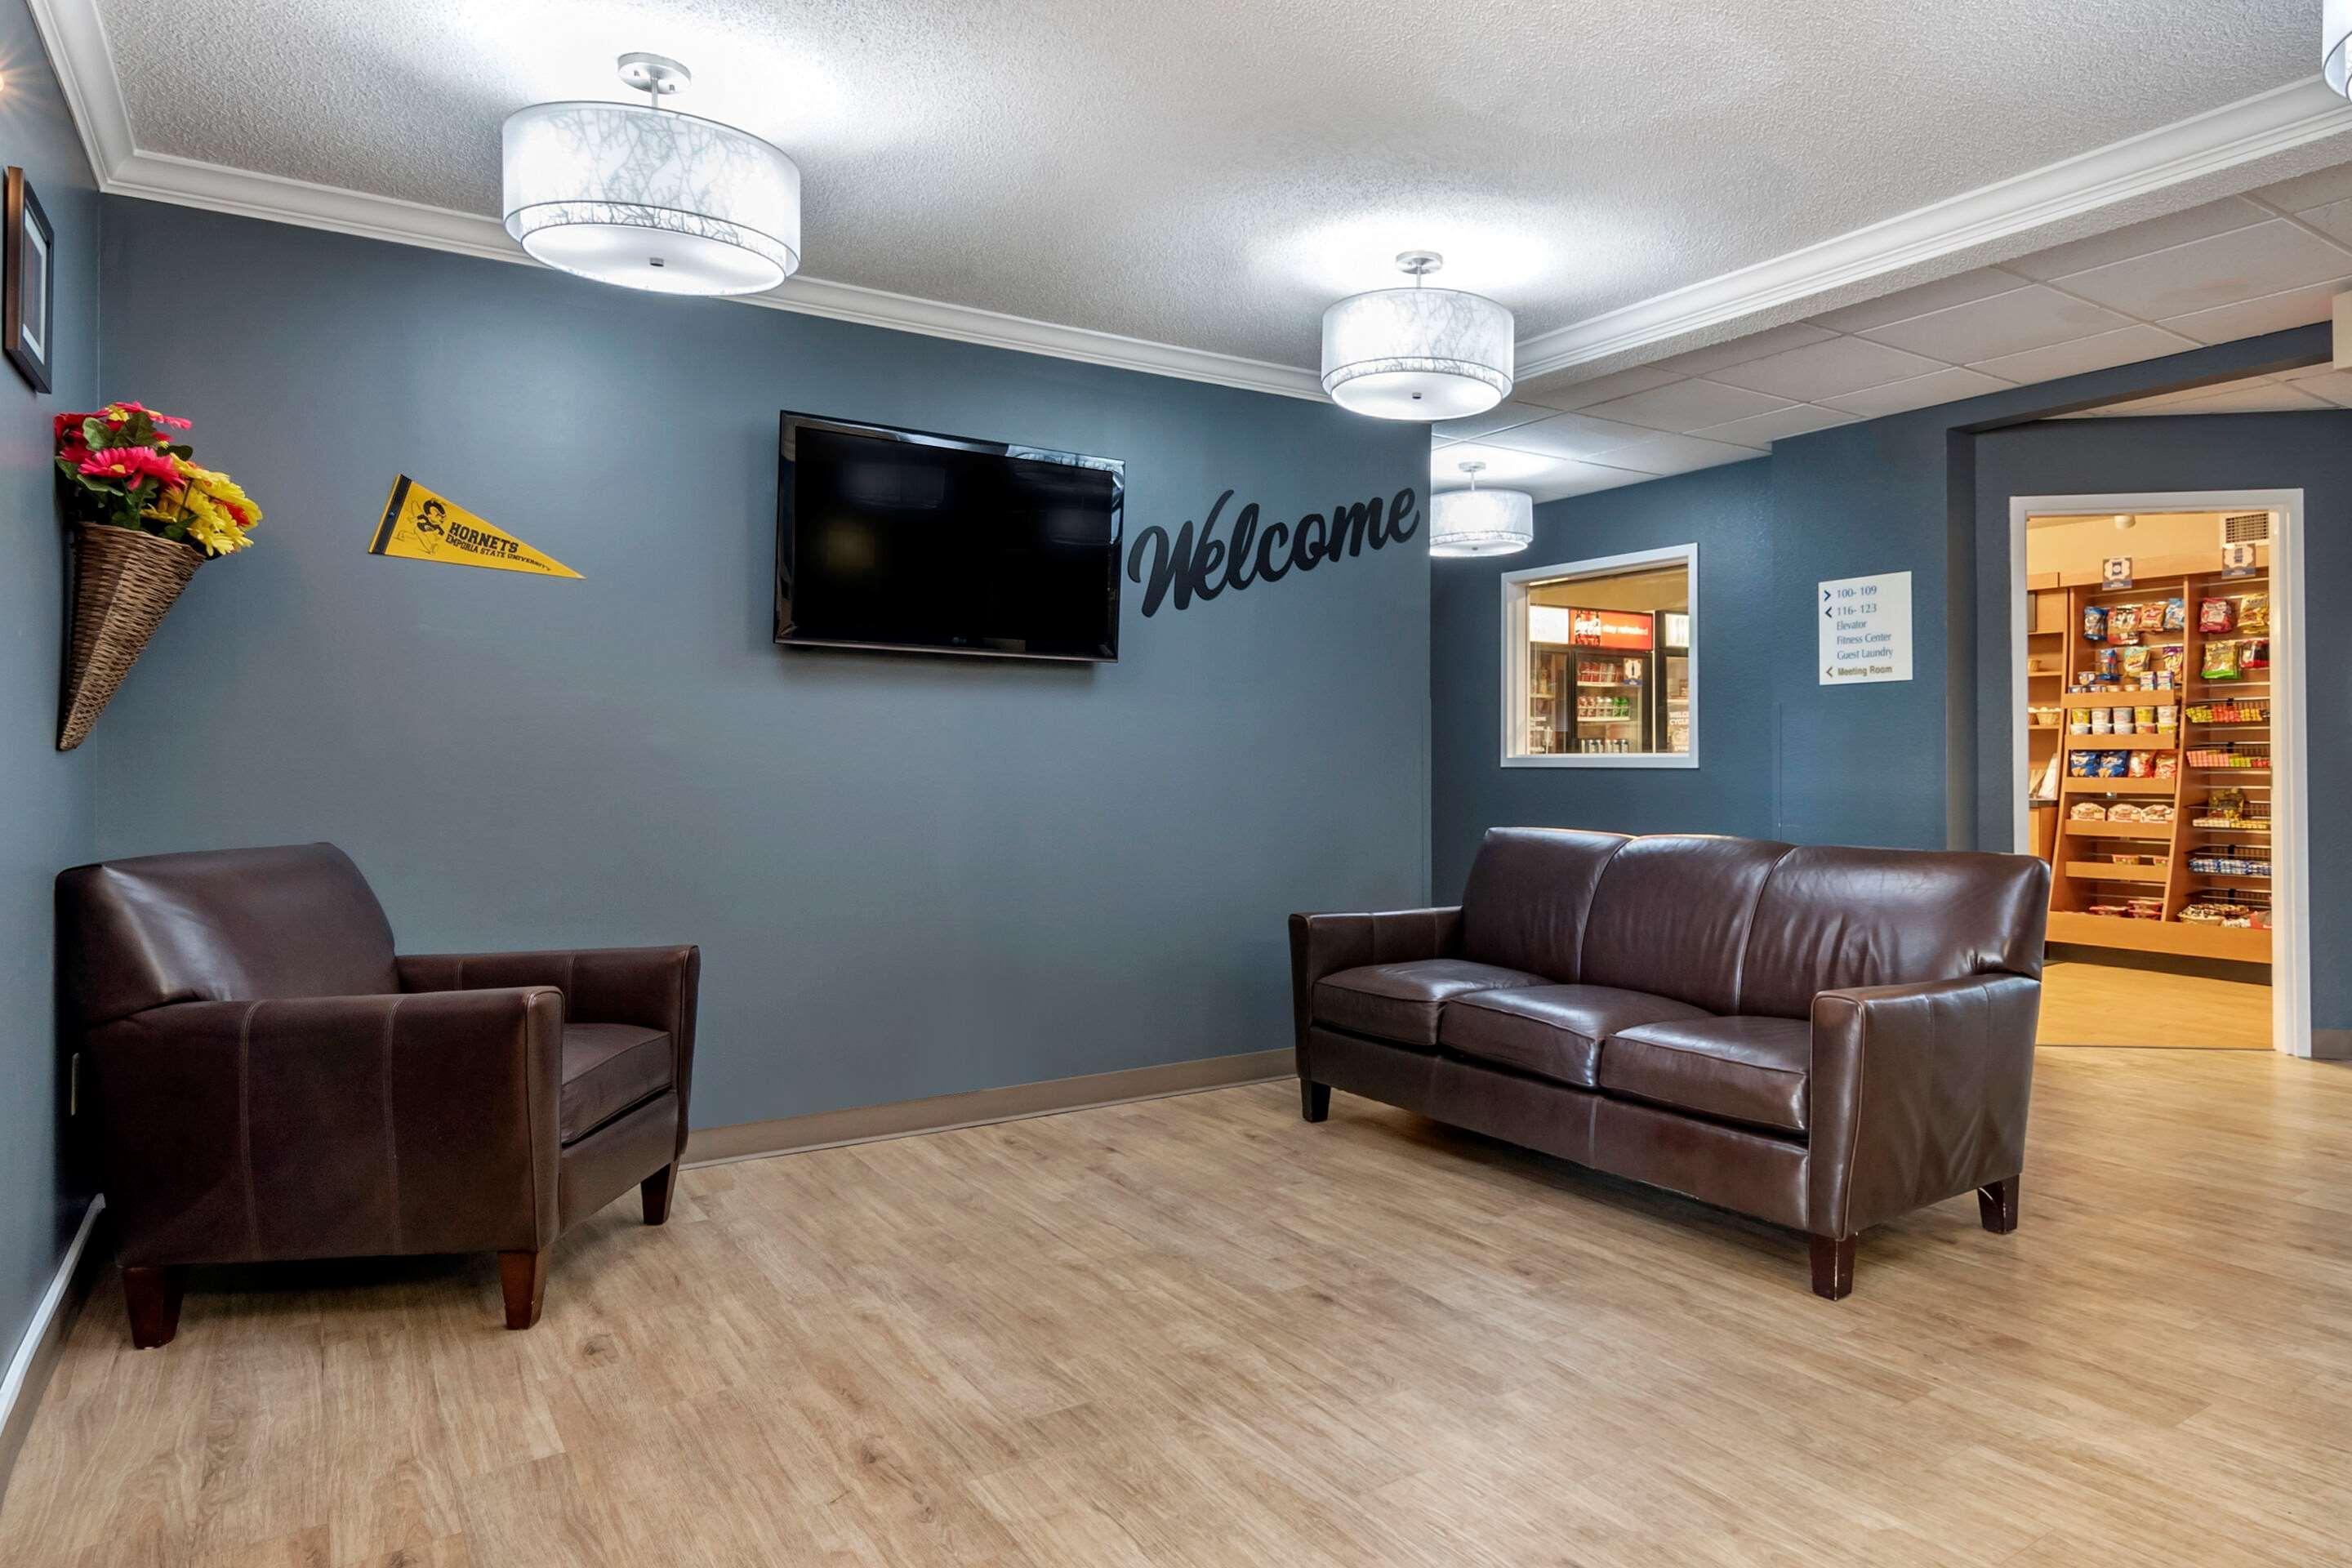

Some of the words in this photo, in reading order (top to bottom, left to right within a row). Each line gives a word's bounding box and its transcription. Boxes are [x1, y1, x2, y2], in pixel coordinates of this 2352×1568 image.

[449, 522, 519, 553] HORNETS
[446, 533, 479, 553] EMPORIA
[480, 546, 506, 558] STATE
[1128, 488, 1421, 617] Welcome
[1860, 585, 1878, 596] 109
[1860, 603, 1878, 614] 123
[1837, 621, 1867, 630] Elevator
[1837, 635, 1863, 645] Fitness
[1864, 633, 1892, 643] Center
[1837, 650, 1860, 661] Guest
[1861, 647, 1894, 658] Laundry
[1838, 666, 1868, 677] Meeting
[1869, 665, 1893, 674] Room
